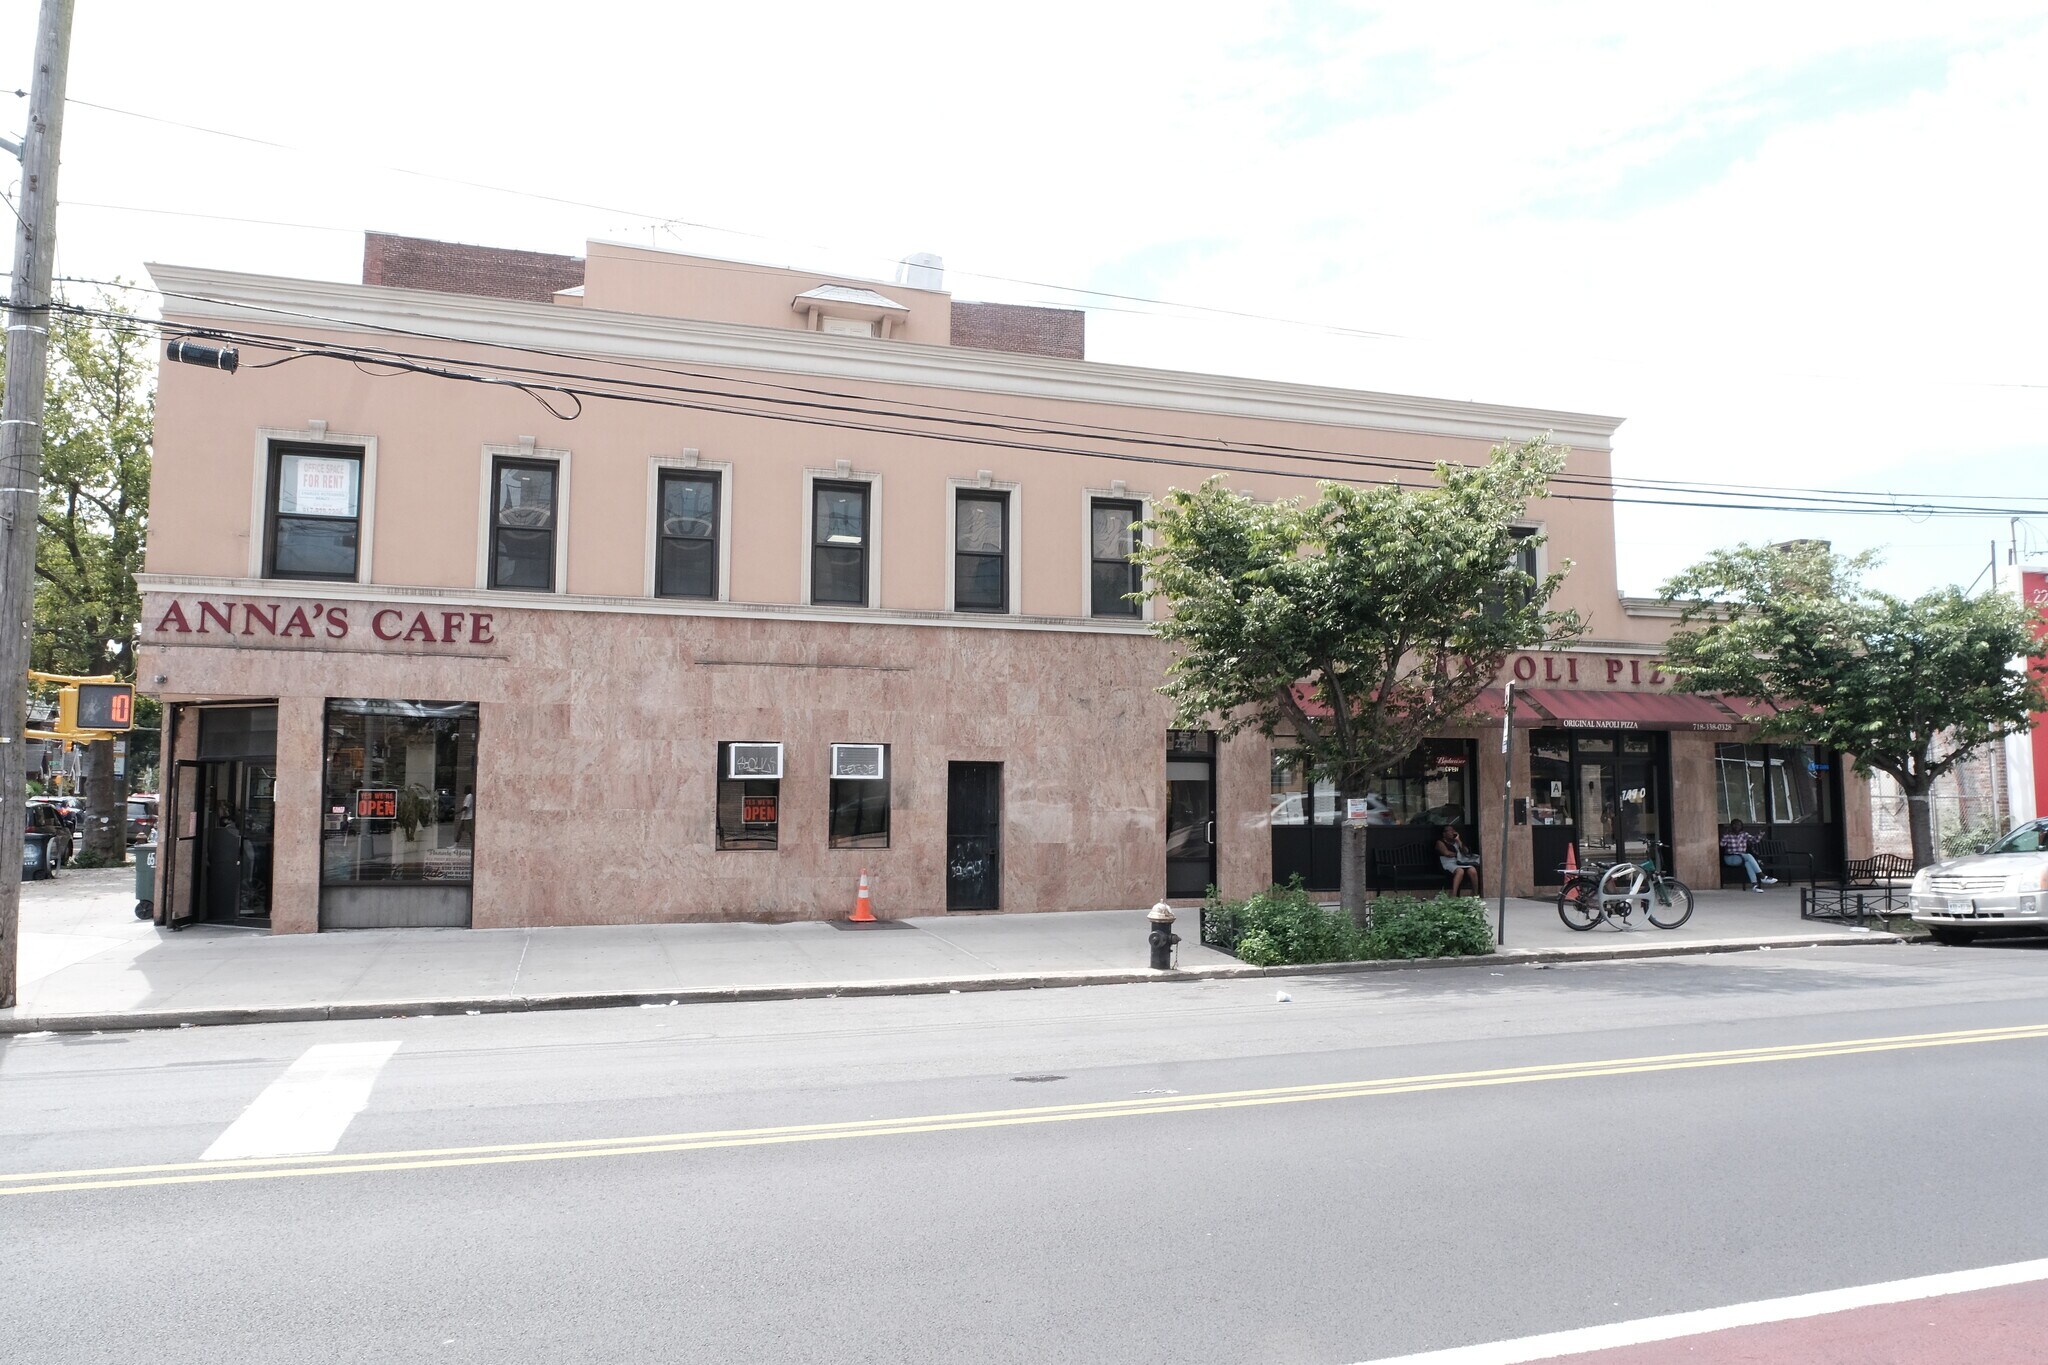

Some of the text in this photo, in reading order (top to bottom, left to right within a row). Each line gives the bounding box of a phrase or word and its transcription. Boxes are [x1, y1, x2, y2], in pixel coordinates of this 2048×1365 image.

[303, 474, 344, 489] FOR RENT
[155, 599, 495, 643] ANNA'S CAFE
[111, 694, 130, 722] 10
[1563, 719, 1638, 729] ORIGINAL NAPOLI PIZZA
[1693, 723, 1732, 731] 718-338-0328
[1553, 783, 1560, 793] A
[360, 792, 394, 800] YES WE'RE
[358, 800, 395, 816] OPEN
[744, 806, 775, 821] OPEN
[146, 852, 156, 866] 65
